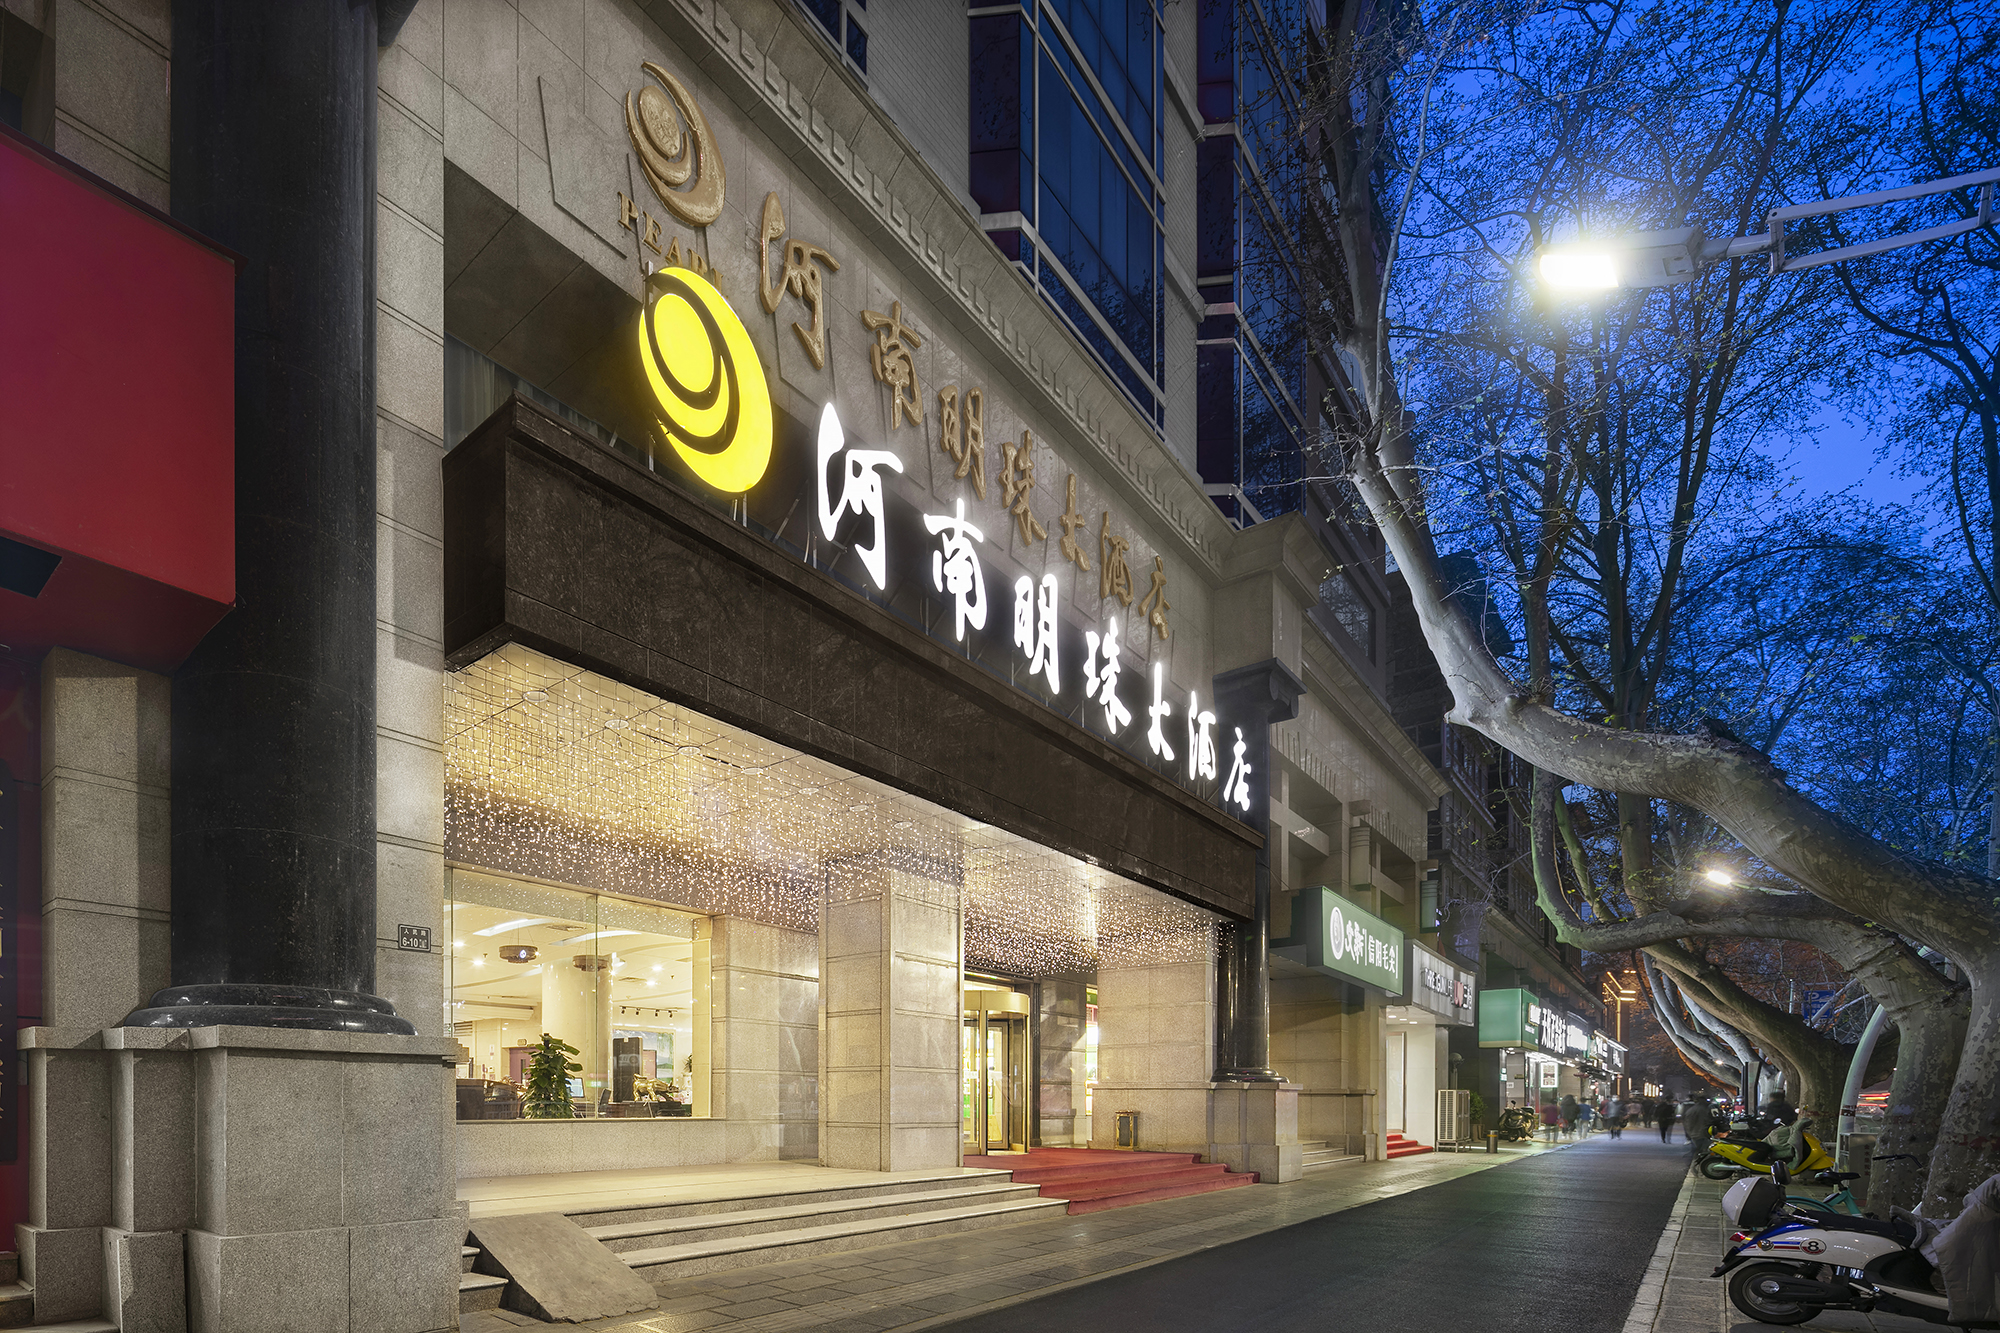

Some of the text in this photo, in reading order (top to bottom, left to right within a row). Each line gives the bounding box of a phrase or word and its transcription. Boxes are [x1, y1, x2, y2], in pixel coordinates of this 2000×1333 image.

[759, 191, 1170, 640] 河南明珠大酒店
[817, 402, 1252, 811] 河南明珠大酒店
[1368, 934, 1395, 973] 信阳毛尖
[1807, 1241, 1820, 1252] 8
